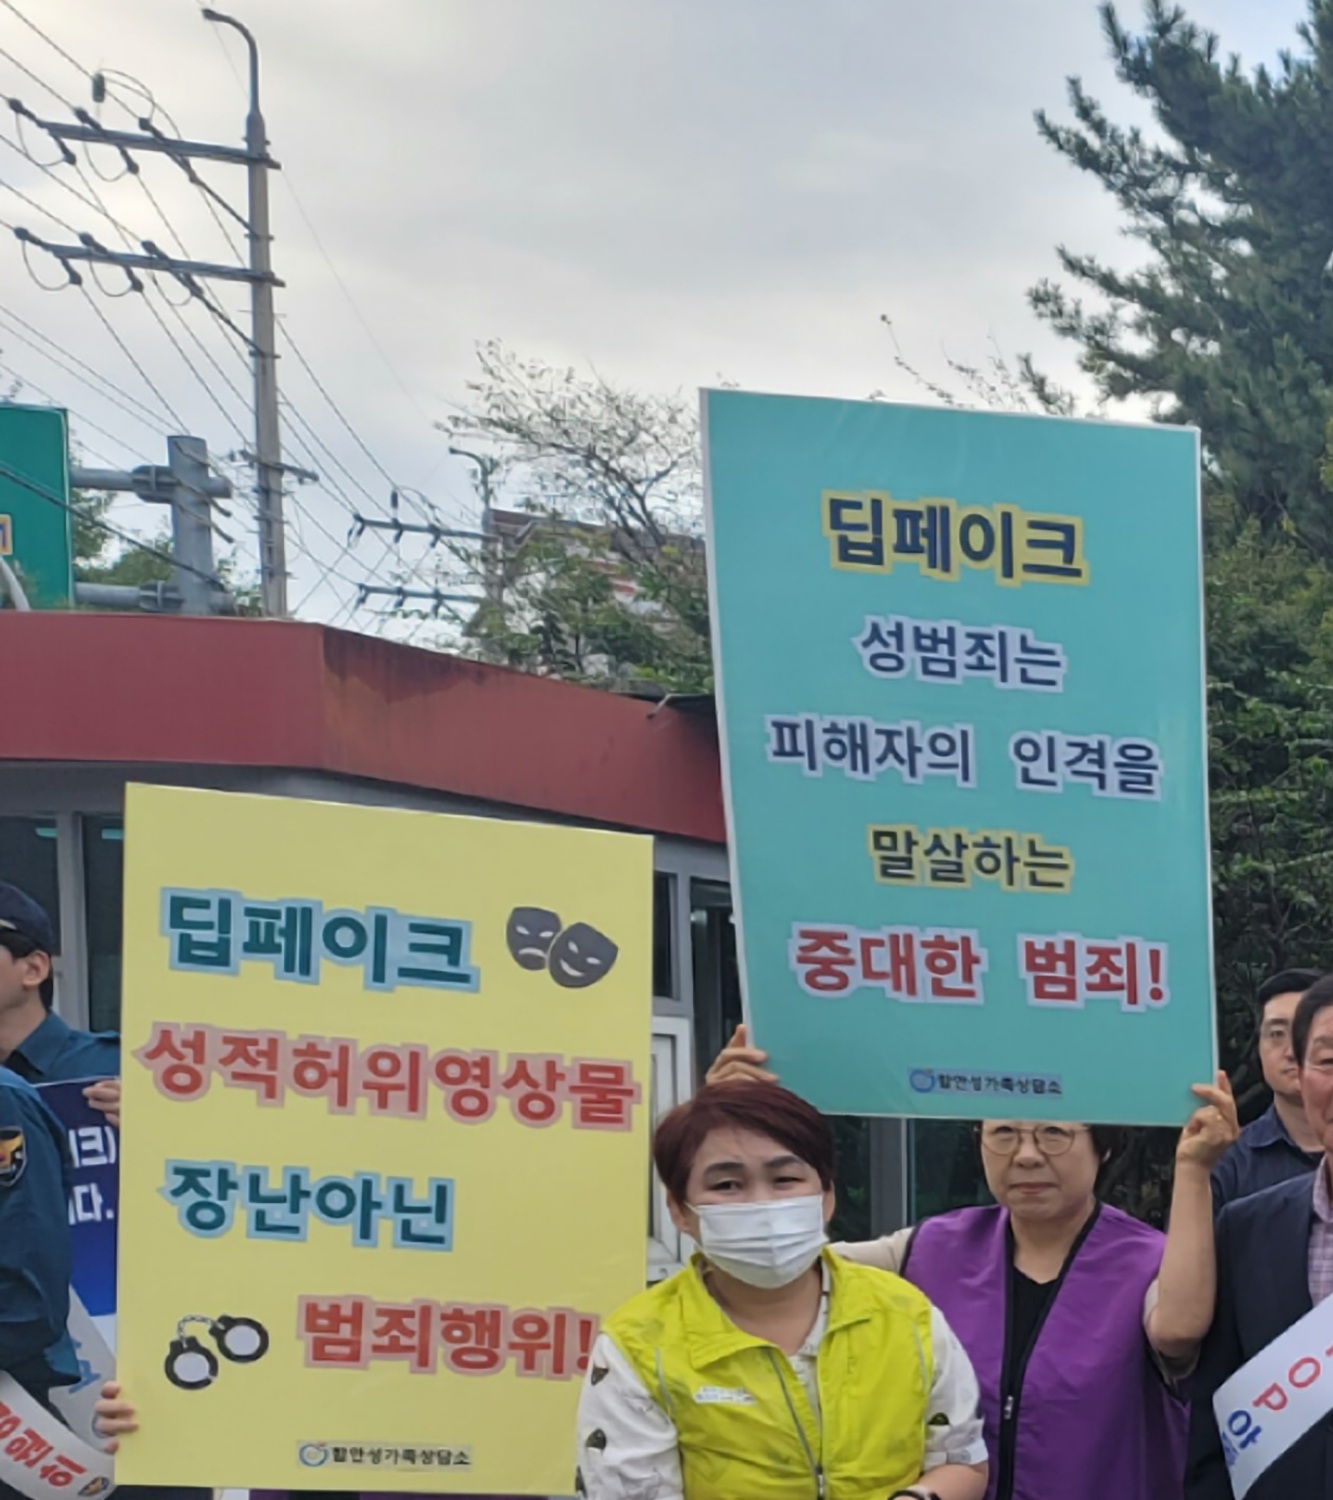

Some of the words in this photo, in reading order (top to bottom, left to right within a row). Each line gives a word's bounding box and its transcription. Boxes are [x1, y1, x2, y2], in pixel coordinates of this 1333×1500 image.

[829, 497, 1083, 578] 딥페이크
[861, 622, 1064, 687] 성범죄는
[769, 719, 973, 782] 피해자의
[1012, 734, 1160, 794] 인격을
[872, 829, 1071, 889] 말살하는
[168, 894, 472, 985] 딥페이크
[795, 928, 981, 998] 중대한
[1025, 938, 1165, 1006] 범죄!
[144, 1027, 635, 1126] 성적허위영상물
[168, 1164, 448, 1244] 장난아닌
[304, 1301, 592, 1374] 범죄행위!
